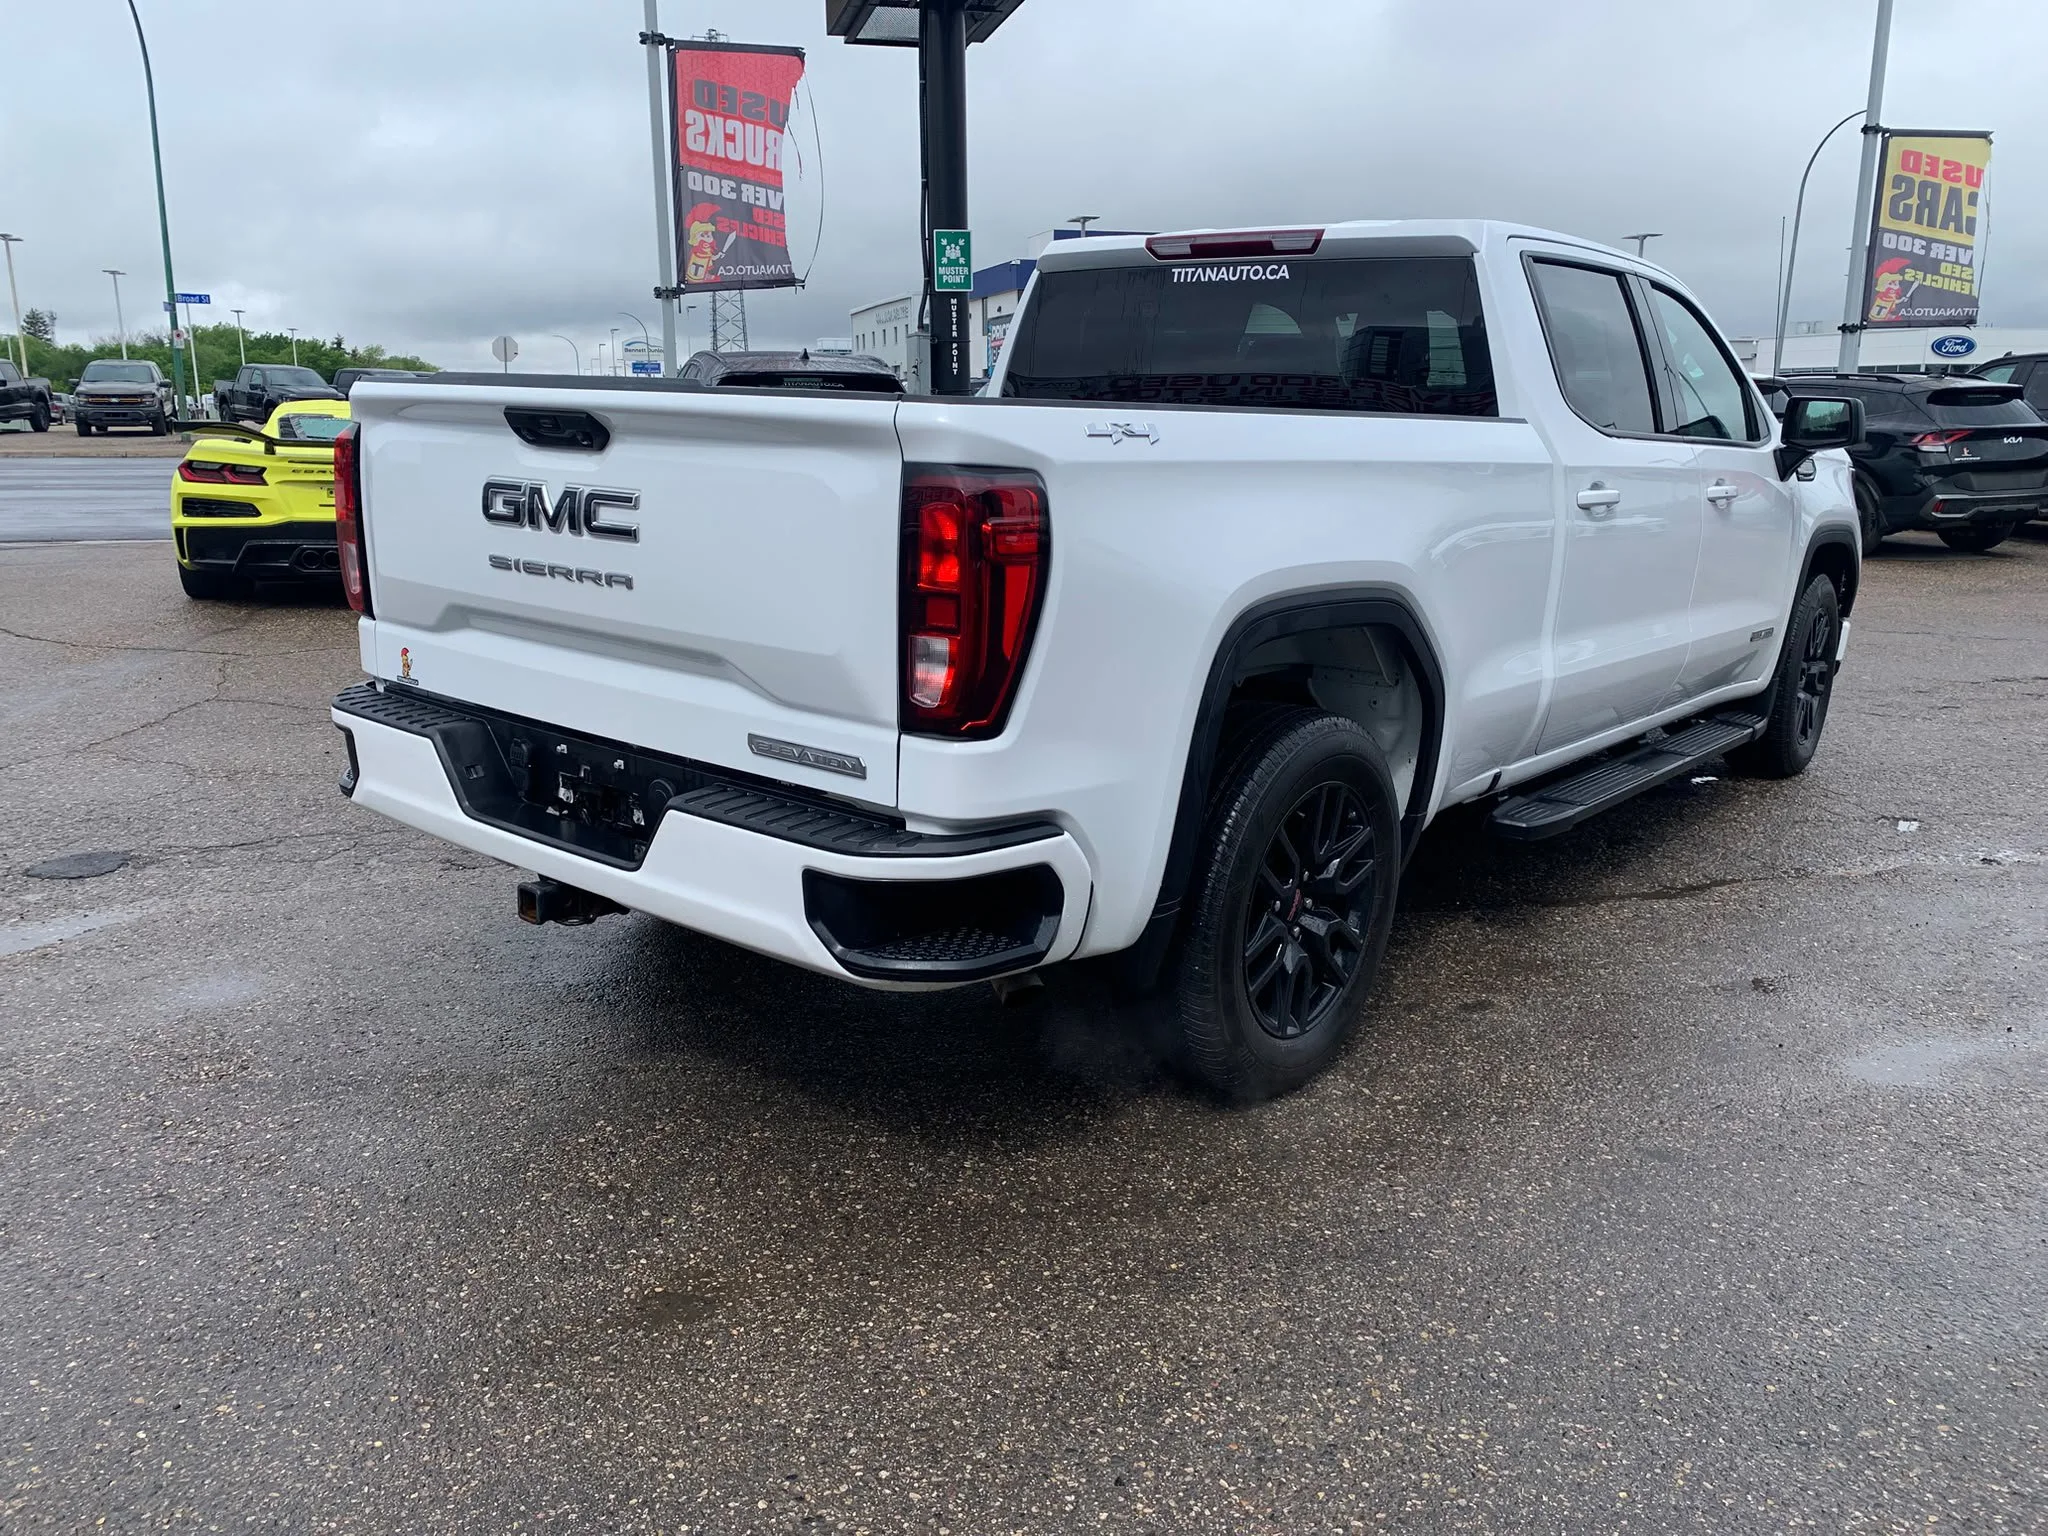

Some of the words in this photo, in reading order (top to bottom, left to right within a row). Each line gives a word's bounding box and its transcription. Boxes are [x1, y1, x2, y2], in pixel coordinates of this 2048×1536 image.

[938, 267, 969, 275] MUSTER
[943, 275, 965, 283] POINT
[1172, 264, 1289, 283] TITANAUTO.CA
[201, 295, 209, 303] St
[950, 298, 958, 338] MUSTER
[1941, 338, 1969, 353] Ford
[951, 343, 959, 375] POINT
[2003, 436, 2023, 444] KIA
[482, 475, 642, 544] GMC
[488, 553, 634, 591] SIERRA
[756, 739, 858, 770] ELEVATION
